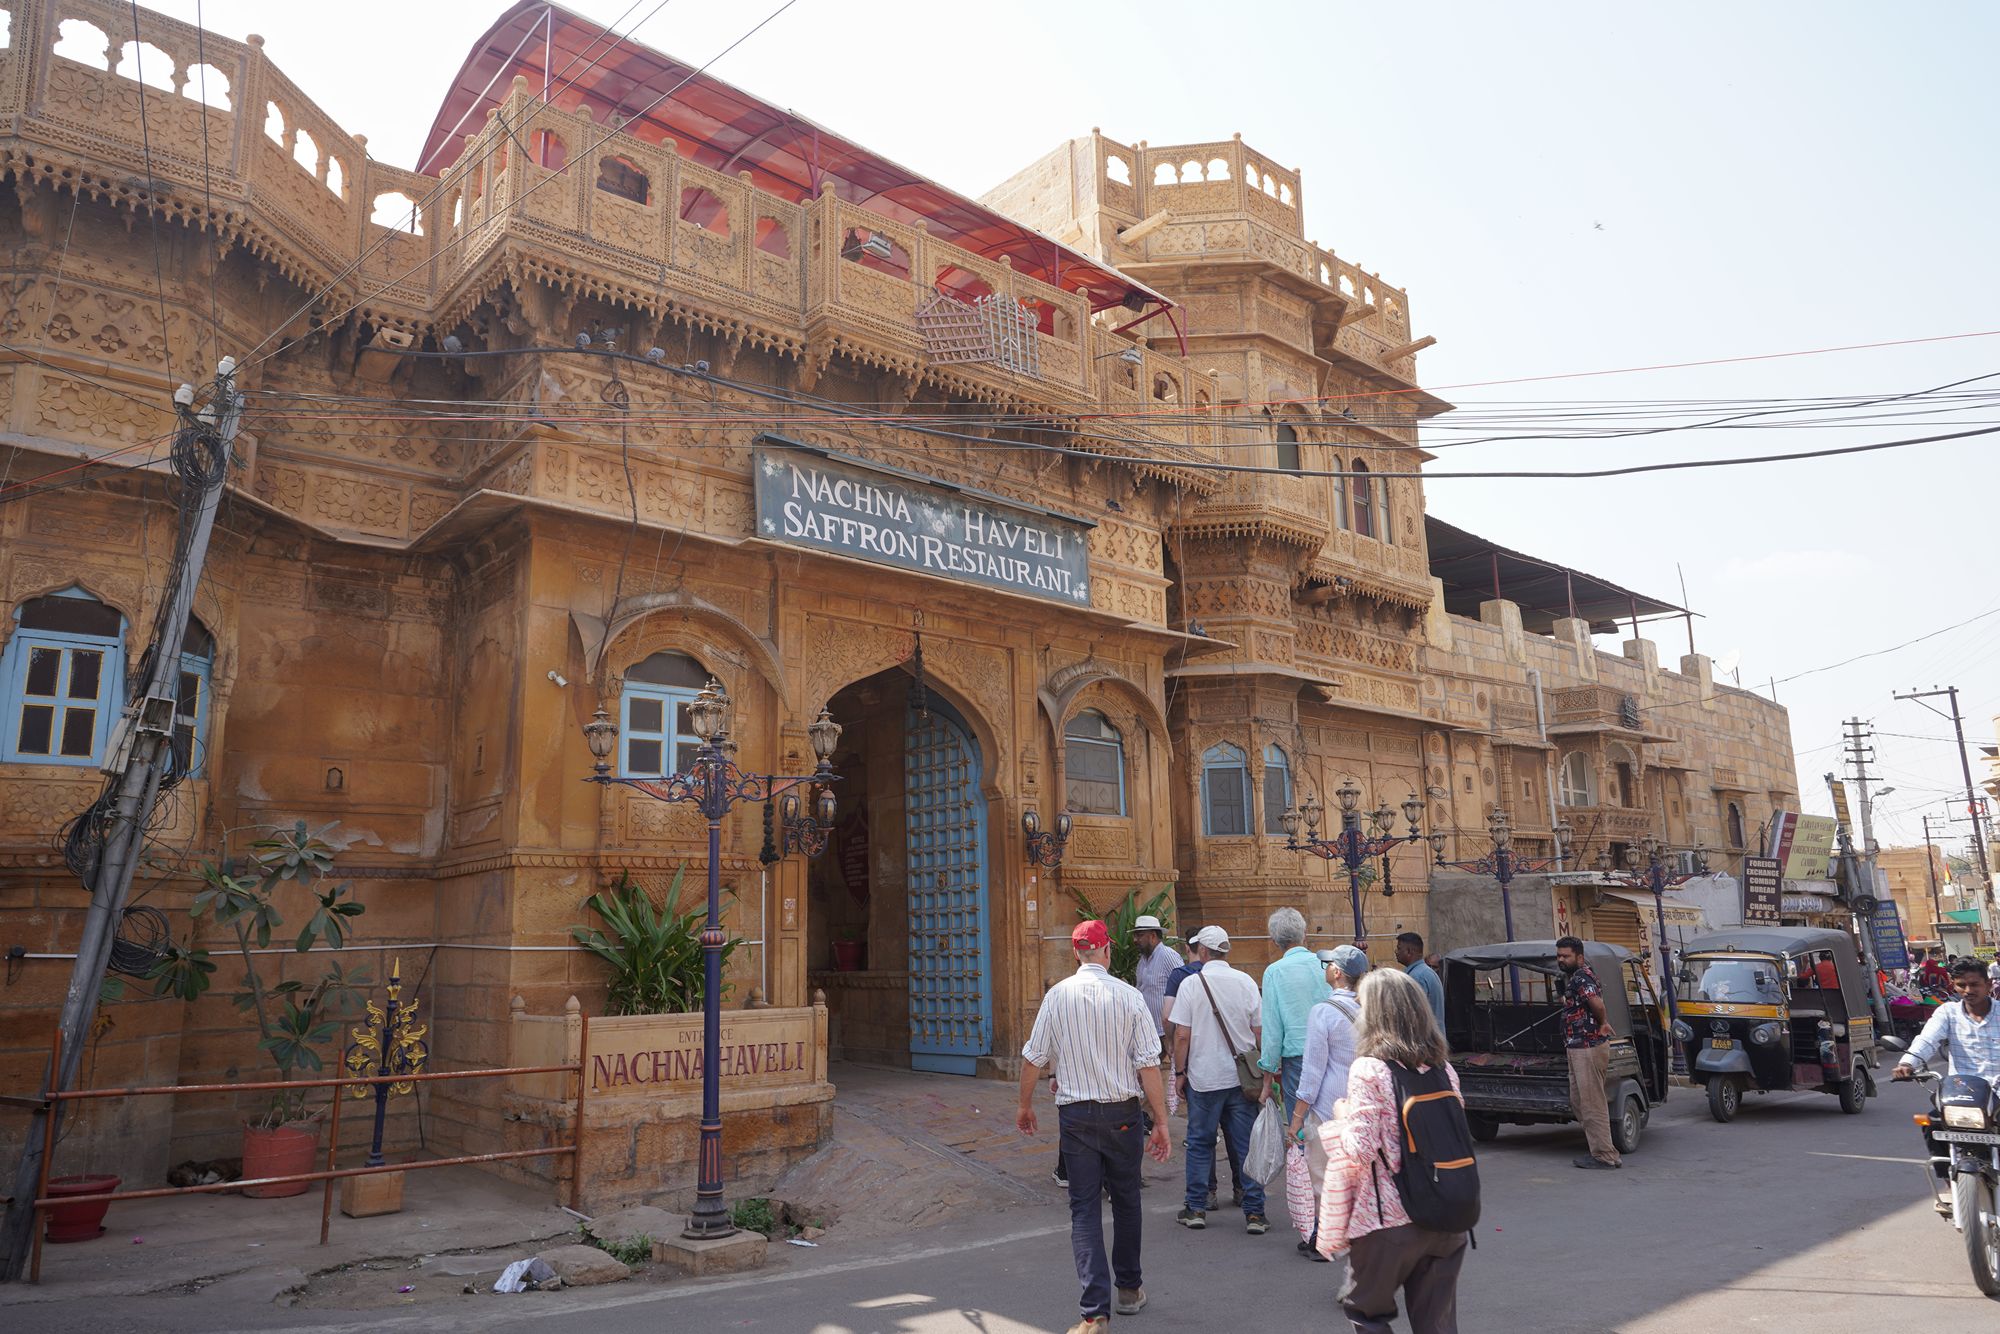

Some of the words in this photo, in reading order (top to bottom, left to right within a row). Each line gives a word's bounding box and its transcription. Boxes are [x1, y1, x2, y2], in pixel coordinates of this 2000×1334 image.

[788, 463, 913, 524] NACHNA
[963, 508, 1064, 560] HAVELI
[783, 501, 918, 561] SAFFRON
[920, 534, 1071, 595] RESTAURANT
[1750, 860, 1777, 868] FOREIGN
[1746, 868, 1780, 877] EXCHANGE
[1750, 903, 1776, 911] CHANGE
[679, 1028, 733, 1043] ENTRCE
[591, 1047, 704, 1089] NACHNA
[719, 1041, 804, 1077] HAVELI
